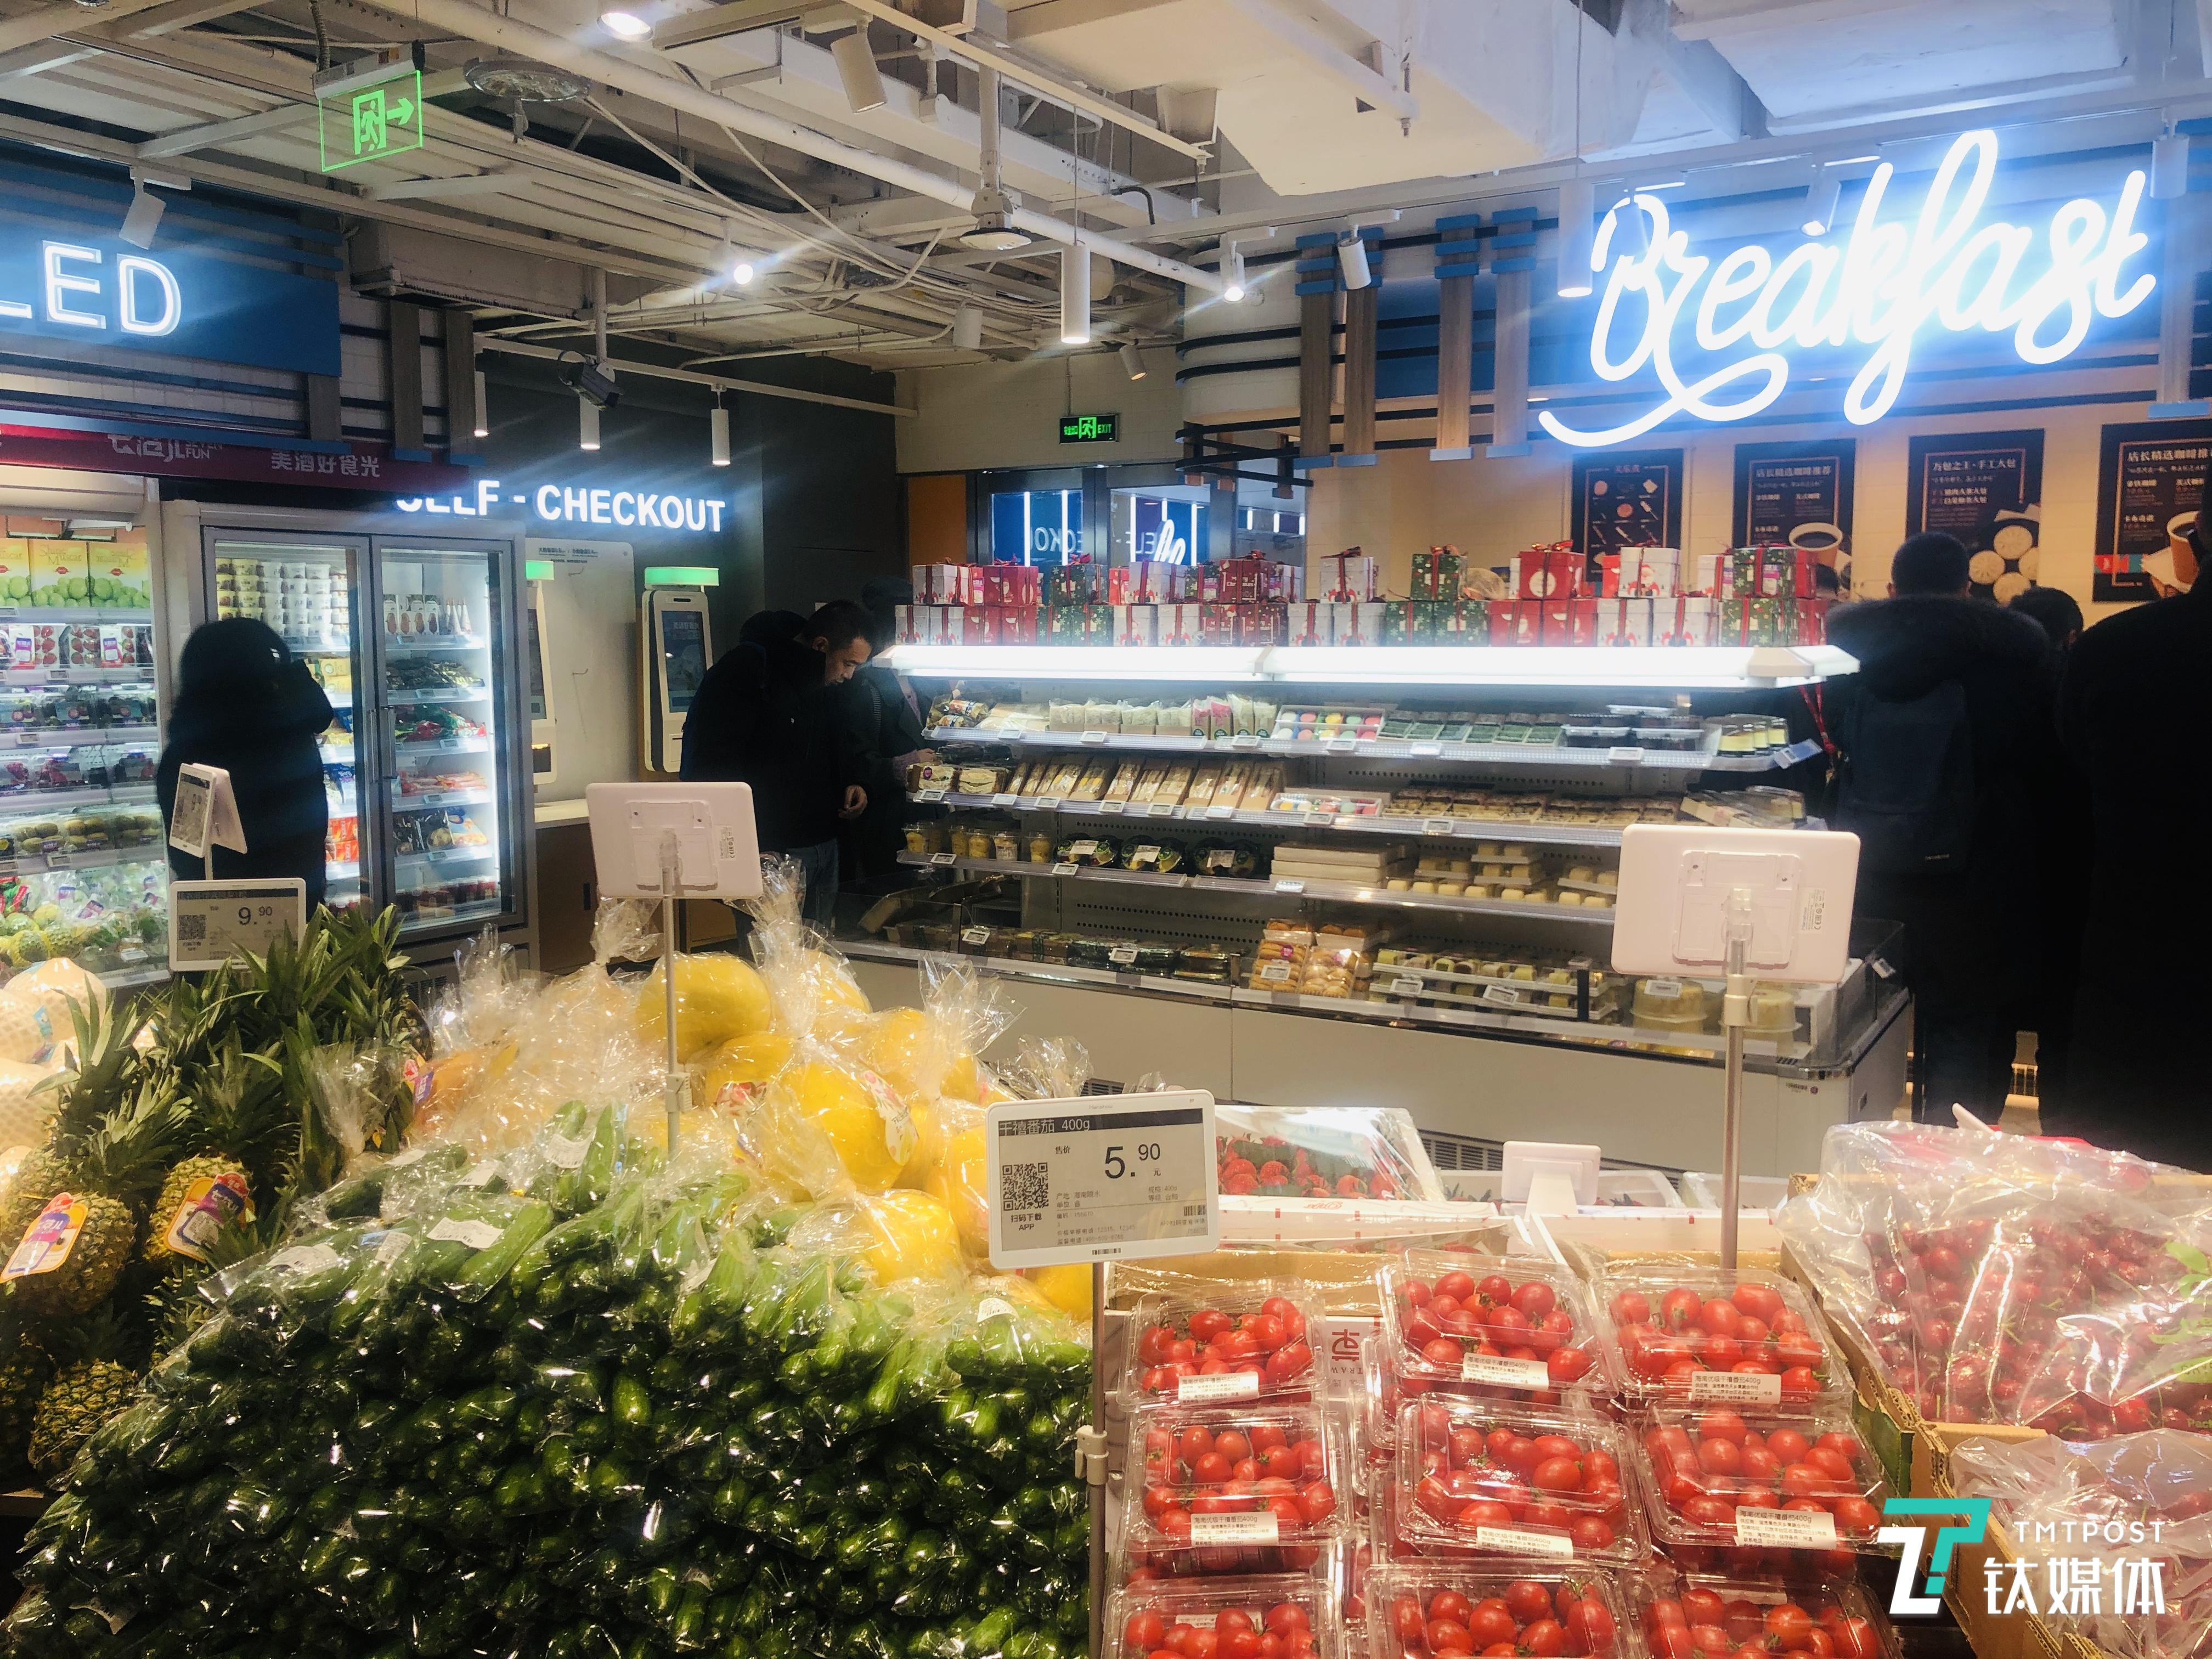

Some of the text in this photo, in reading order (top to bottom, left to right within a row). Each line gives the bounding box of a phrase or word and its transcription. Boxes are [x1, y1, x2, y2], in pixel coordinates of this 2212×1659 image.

[1538, 129, 2156, 447] Breakfast
[1097, 424, 1112, 433] EXIT
[185, 447, 210, 459] FUN
[271, 452, 381, 478] 美酒好食光
[537, 485, 726, 532] CHECKOUT
[999, 1118, 1091, 1136] 千禧番茄 400g
[1055, 1145, 1070, 1154] 售价
[1011, 1213, 1042, 1223] 扫码下载
